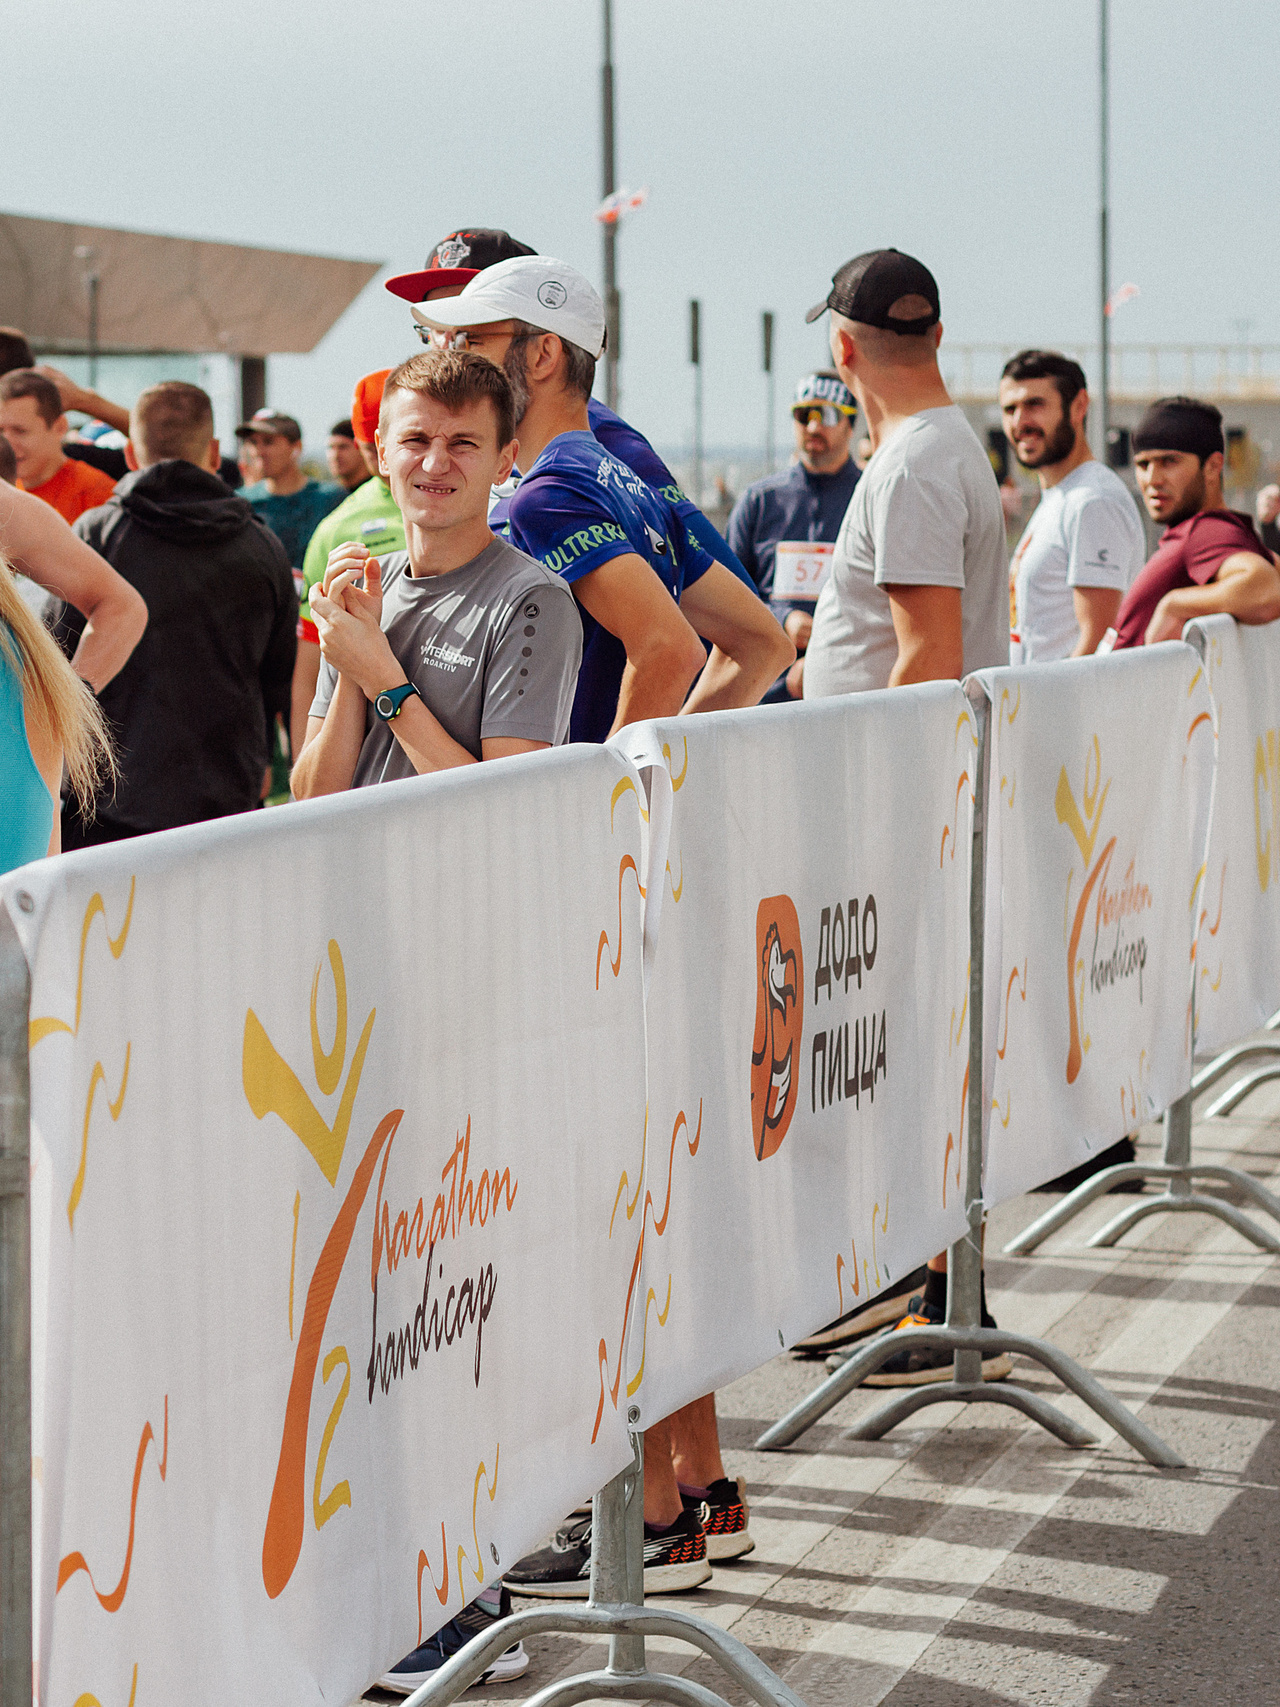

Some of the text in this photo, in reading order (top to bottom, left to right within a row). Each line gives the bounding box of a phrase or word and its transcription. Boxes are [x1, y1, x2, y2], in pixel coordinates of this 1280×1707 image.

[795, 560, 824, 583] 57
[815, 894, 878, 1005] ДОДО
[812, 1009, 887, 1114] ПИЦЦА
[366, 1241, 498, 1404] handicap
